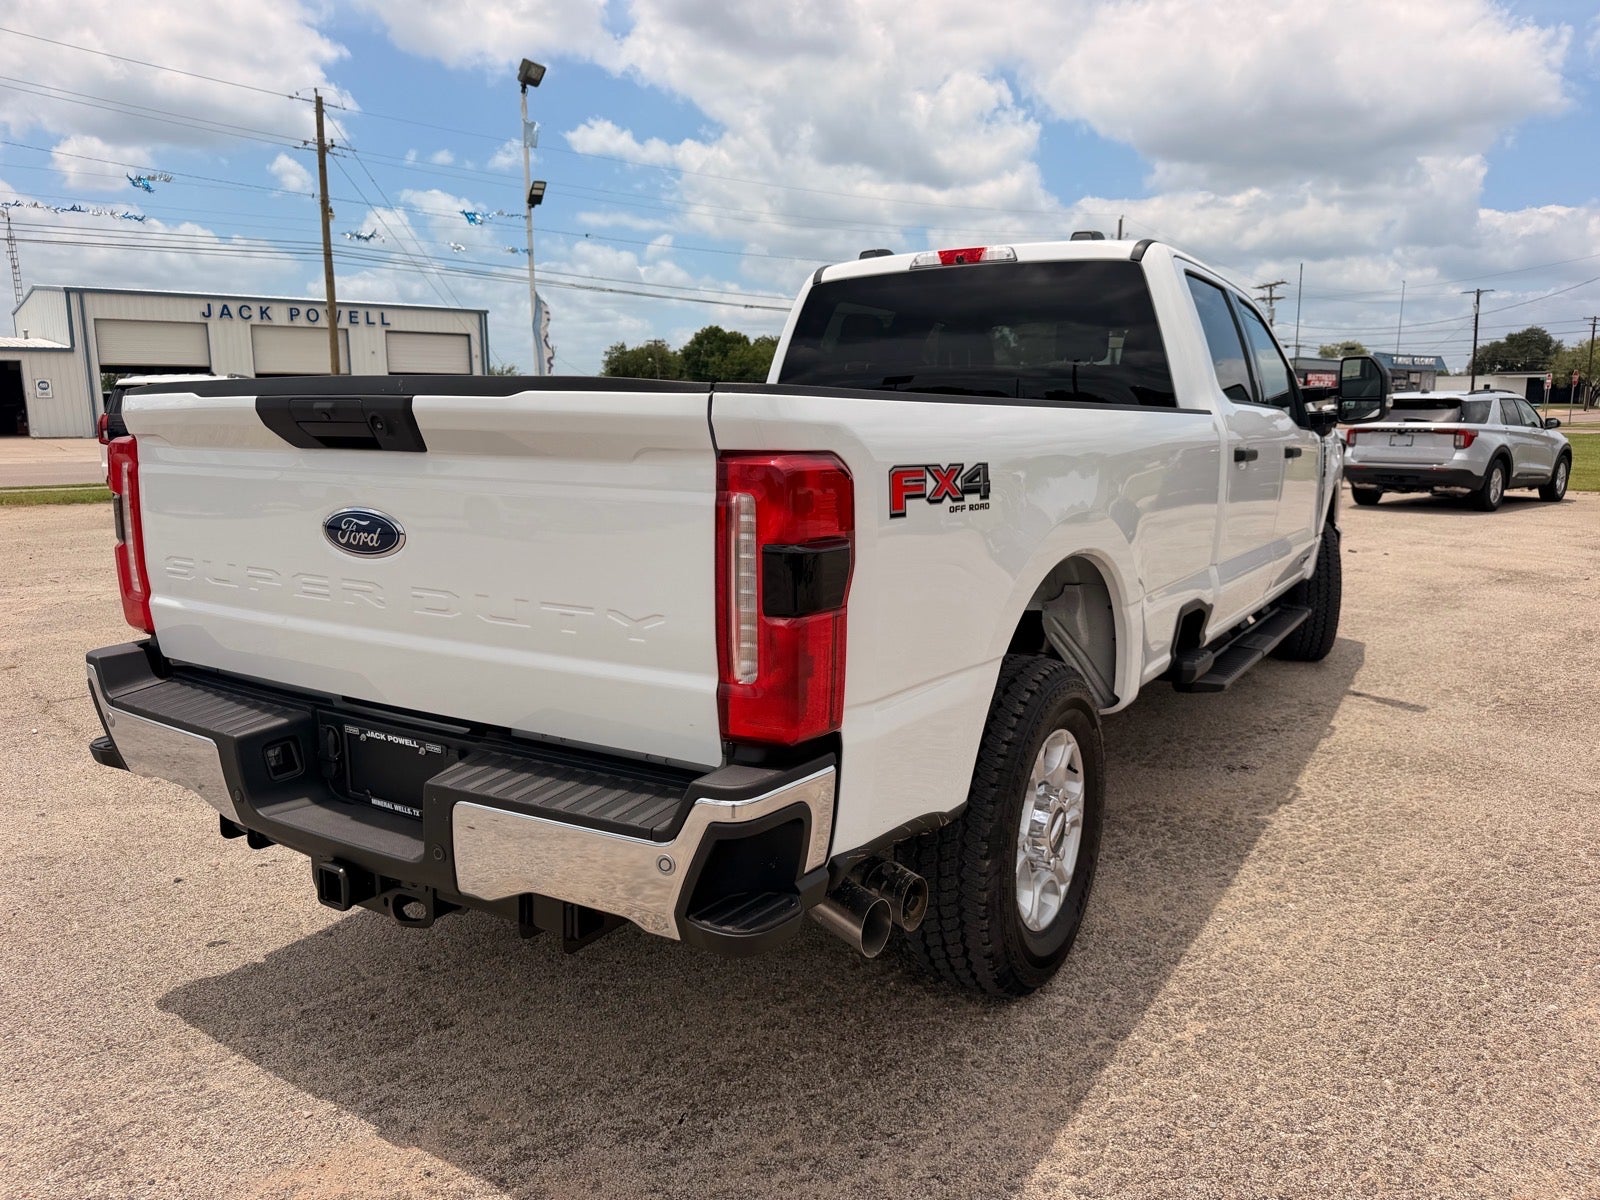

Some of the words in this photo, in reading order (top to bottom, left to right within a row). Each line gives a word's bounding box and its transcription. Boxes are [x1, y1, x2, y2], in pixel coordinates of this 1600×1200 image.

[202, 303, 272, 321] JACK
[888, 462, 991, 520] FX4
[949, 505, 967, 514] OFF
[969, 502, 990, 512] ROAD
[338, 517, 382, 547] Ford
[165, 555, 387, 610] SUPER
[410, 586, 666, 643] DUTY
[366, 730, 387, 741] JACK
[387, 735, 420, 749] POWELL
[371, 798, 394, 810] MINERAL
[394, 804, 413, 816] WELLS,
[413, 809, 420, 817] TX
